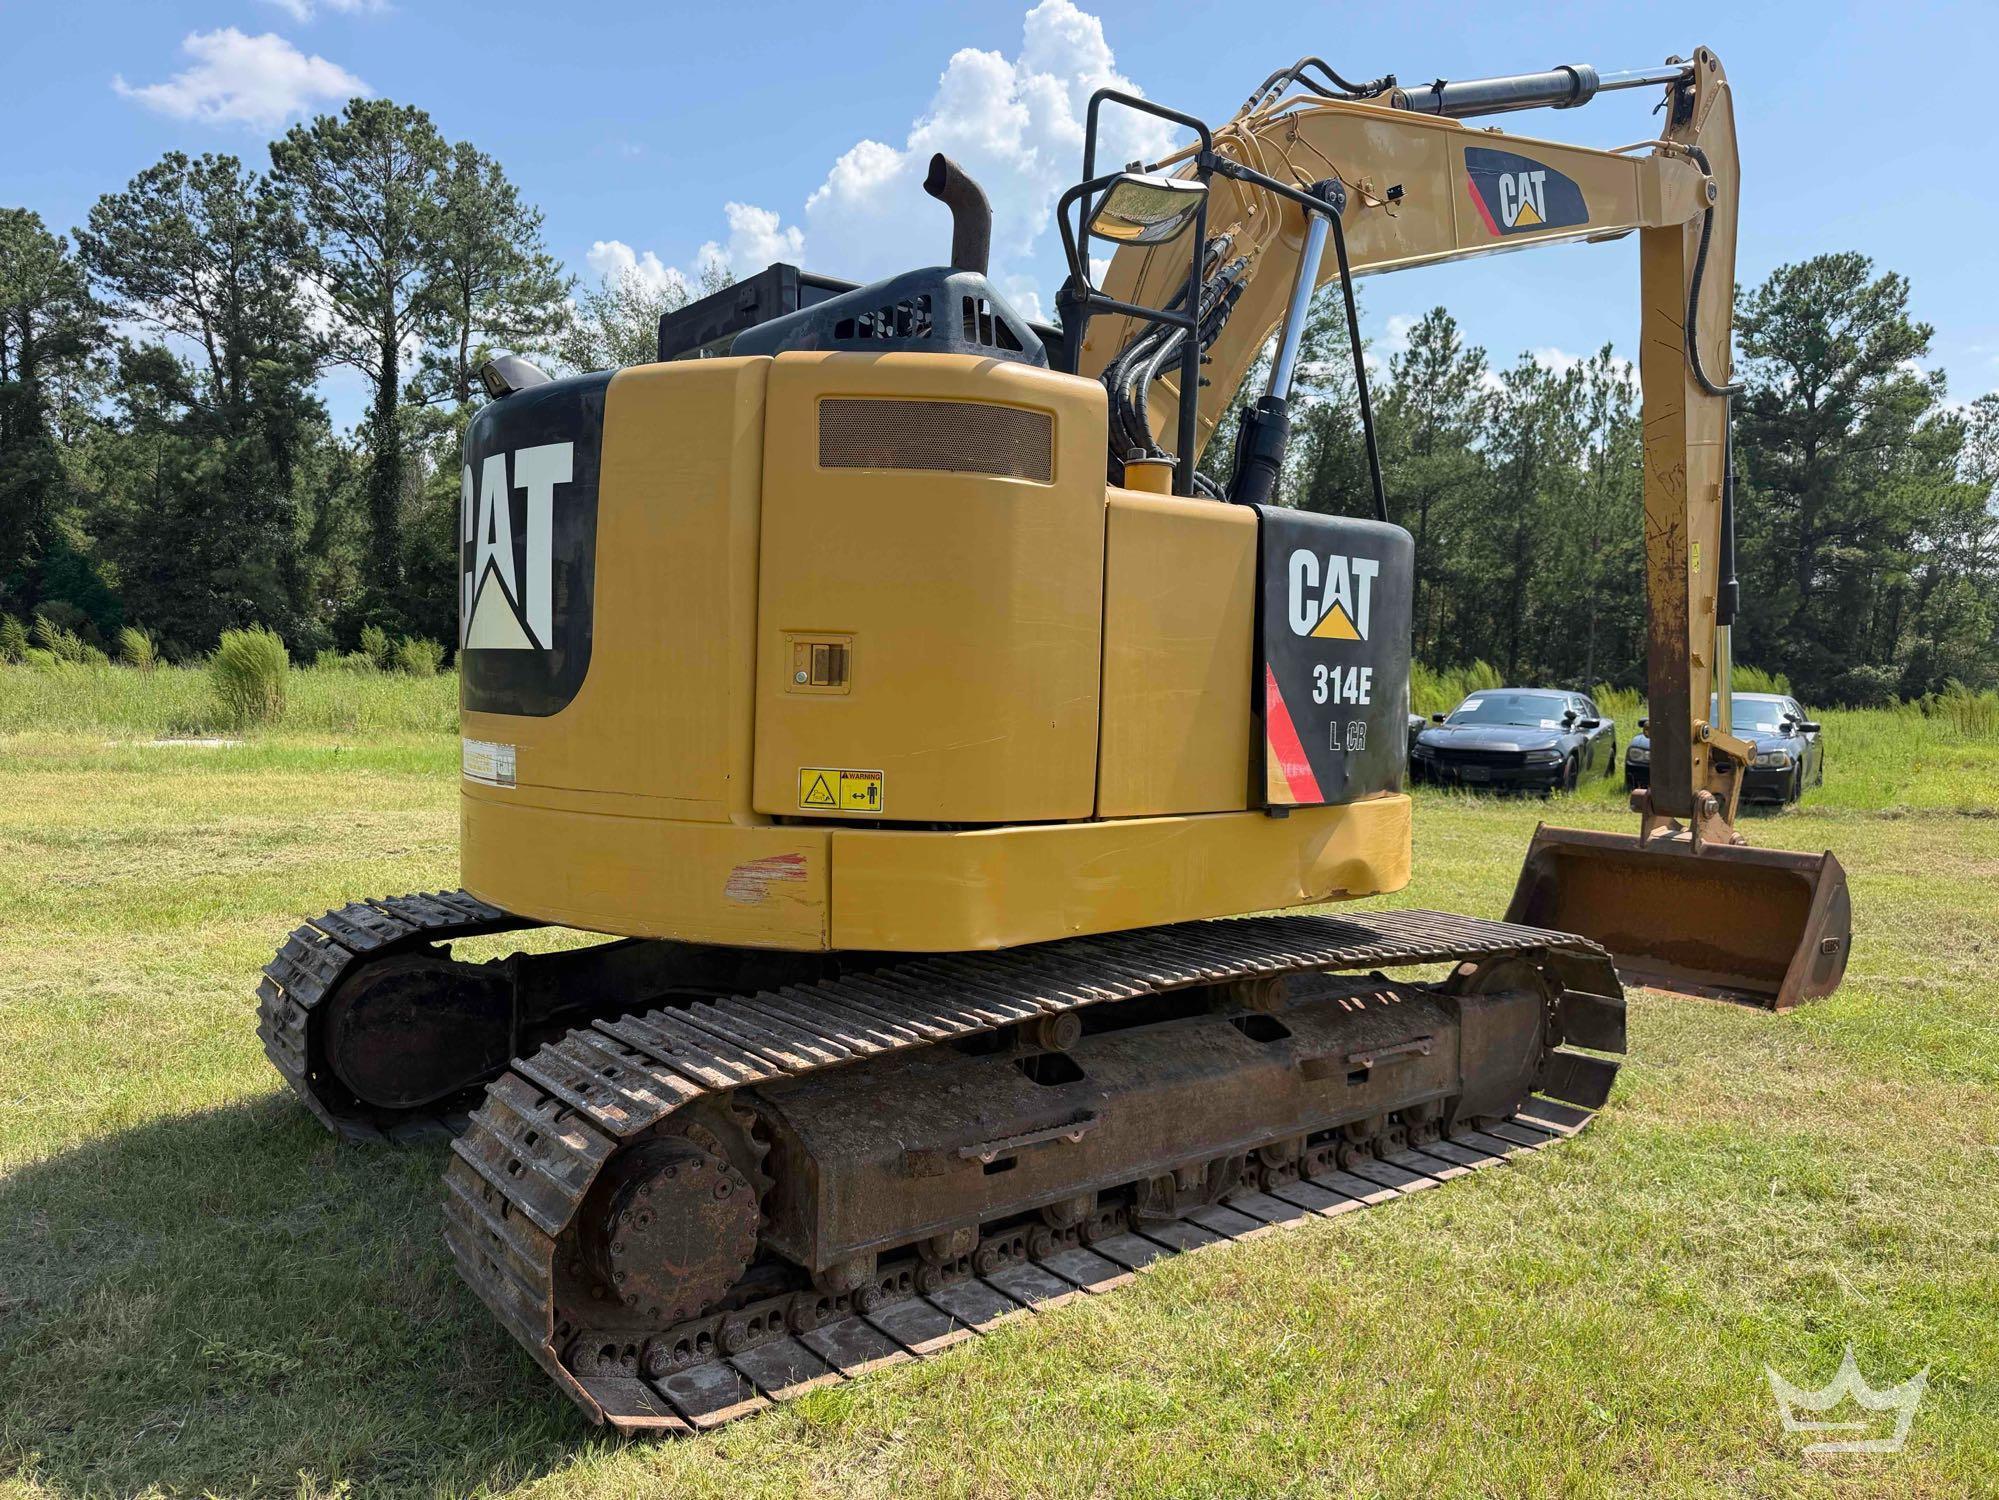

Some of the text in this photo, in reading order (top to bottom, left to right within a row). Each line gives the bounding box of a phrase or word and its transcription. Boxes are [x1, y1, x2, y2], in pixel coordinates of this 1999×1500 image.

[1498, 170, 1547, 228] CAT
[461, 441, 574, 650] CAT
[1288, 549, 1380, 641] CAT
[1312, 664, 1373, 705] 314E
[1330, 721, 1367, 751] L CR
[849, 773, 881, 781] WARNING
